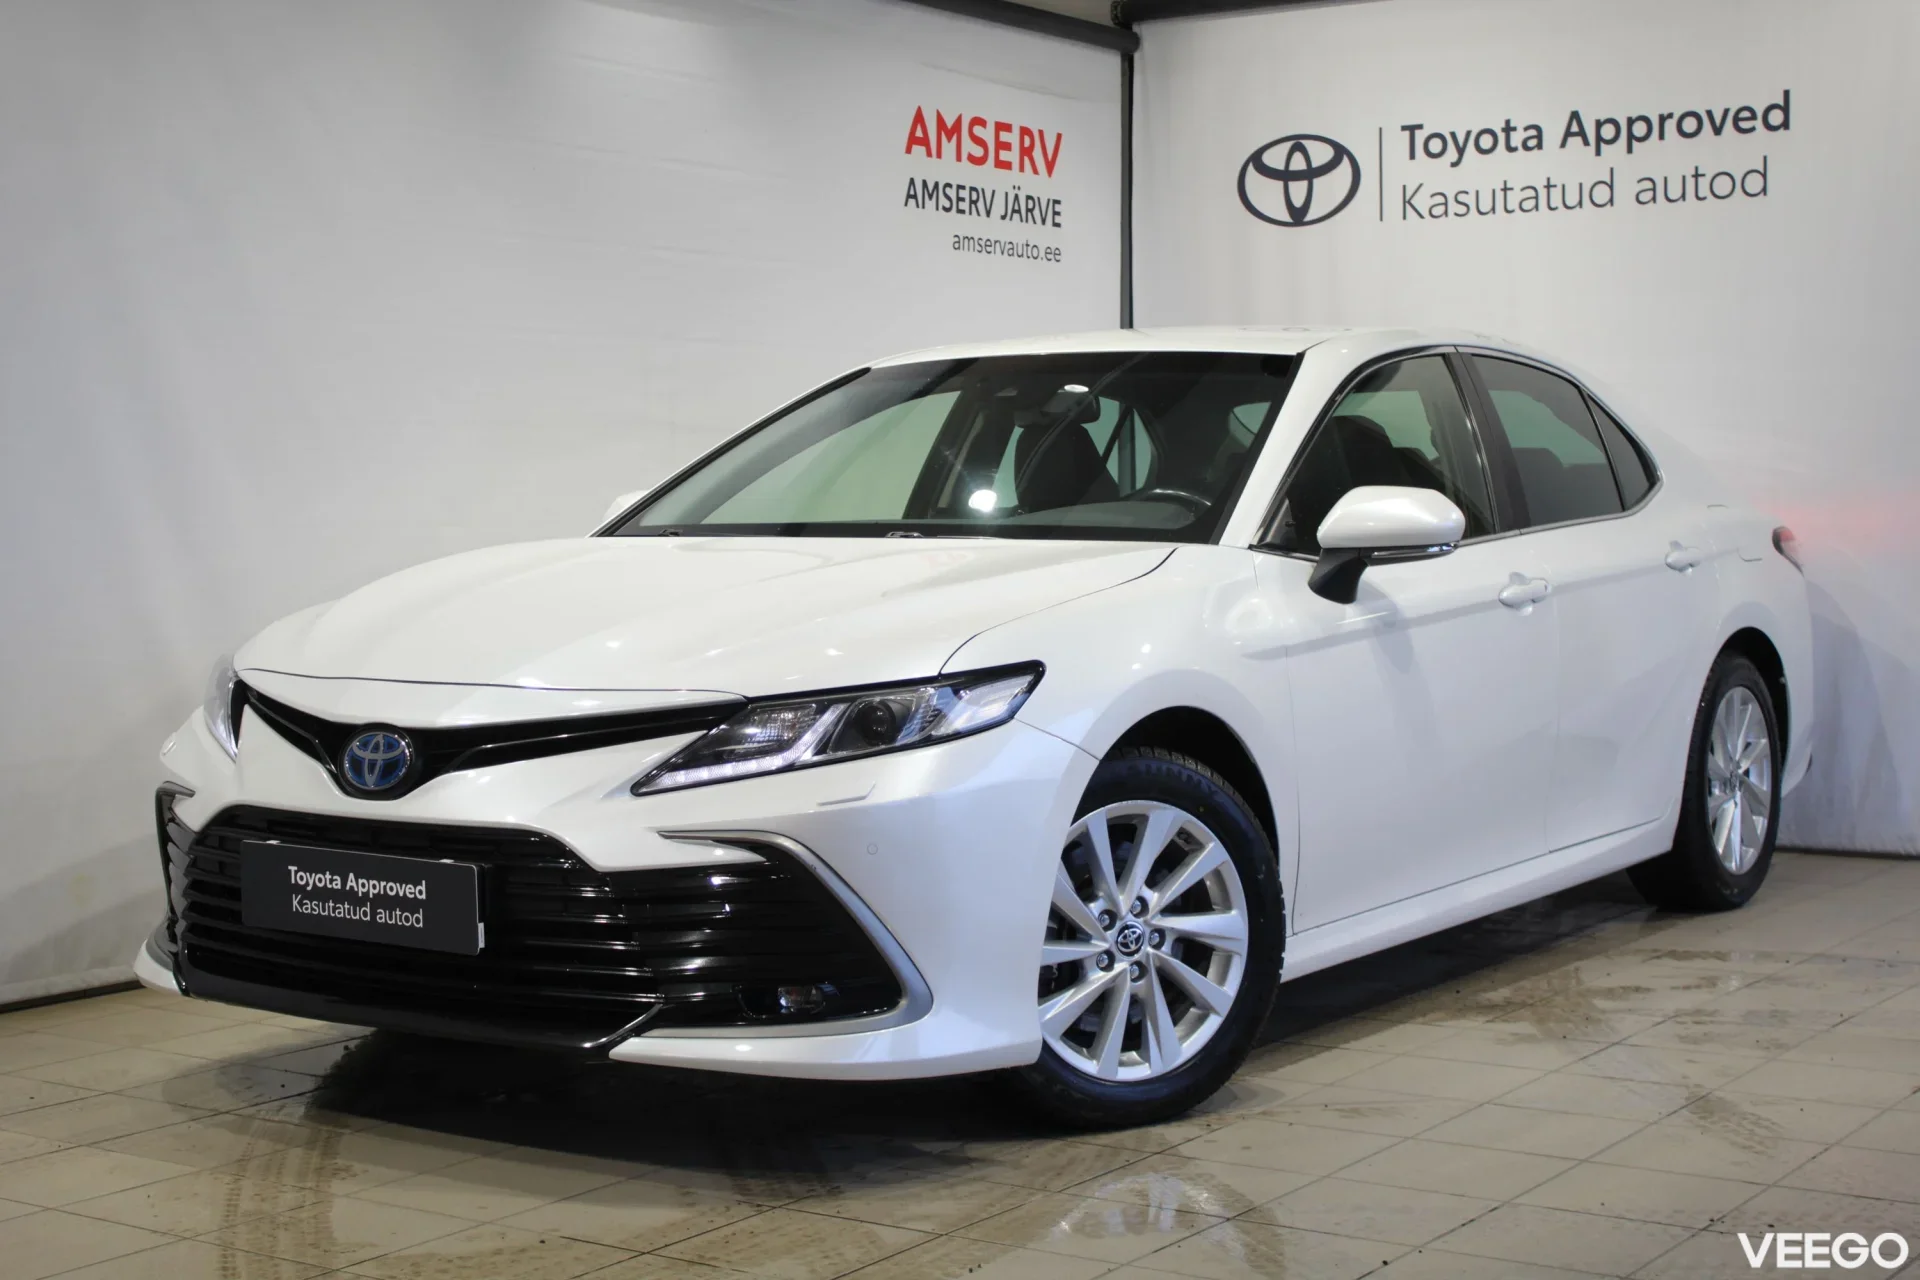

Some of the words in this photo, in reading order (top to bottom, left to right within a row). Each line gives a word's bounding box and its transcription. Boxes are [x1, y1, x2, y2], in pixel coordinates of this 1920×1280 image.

[905, 105, 1062, 178] AMSERV
[1401, 117, 1545, 168] Toyota
[1559, 89, 1791, 157] Approved
[904, 177, 996, 218] AMSERV
[1000, 185, 1062, 228] JÄRVE
[1402, 166, 1615, 221] Kasutatud
[1635, 155, 1769, 206] autod
[952, 234, 1062, 262] amservauto.ee
[288, 865, 341, 890] Toyota
[346, 872, 426, 900] Approved
[292, 893, 370, 921] Kasutatud
[376, 908, 423, 928] autod
